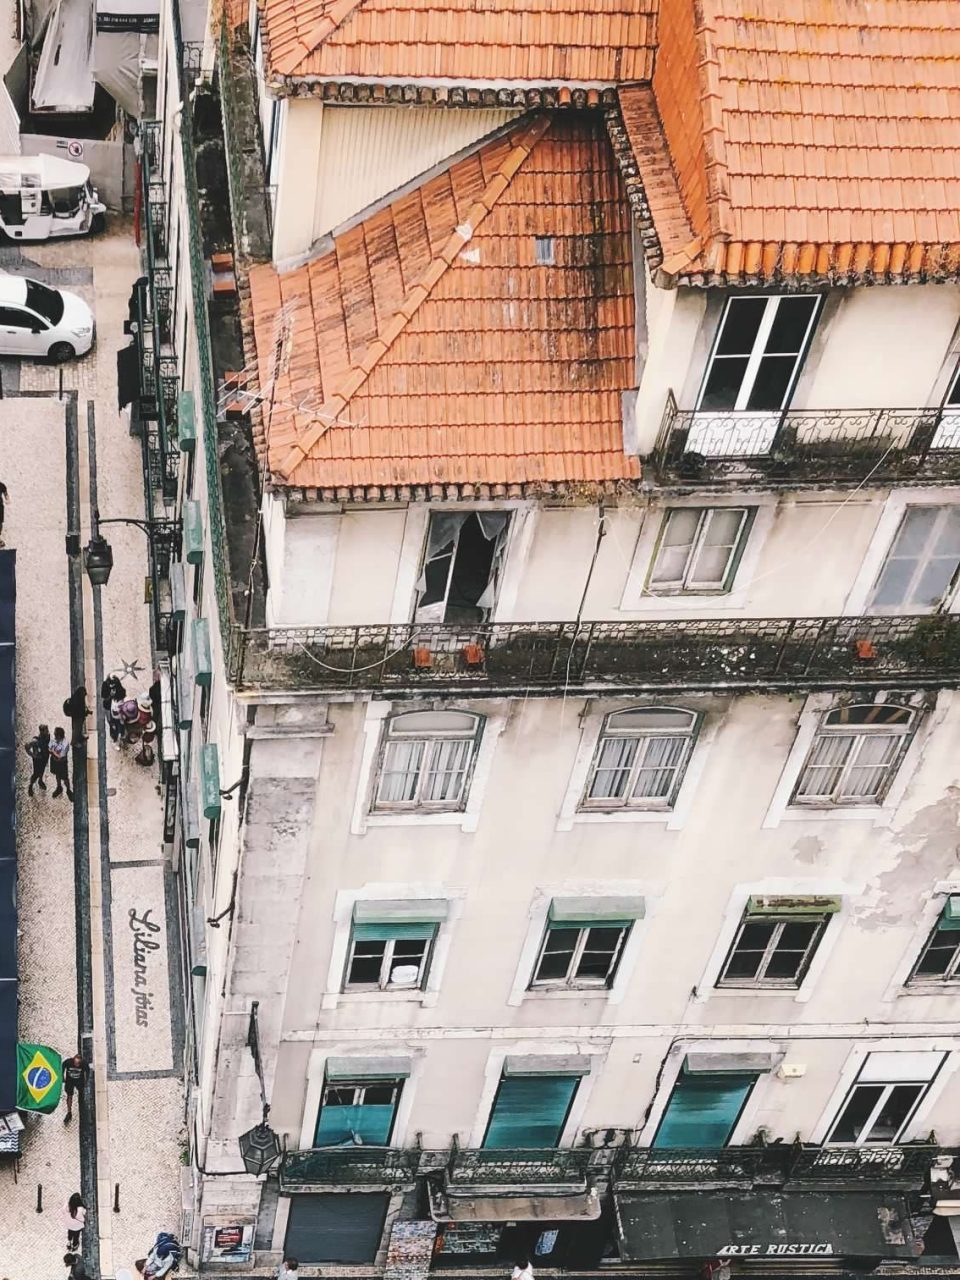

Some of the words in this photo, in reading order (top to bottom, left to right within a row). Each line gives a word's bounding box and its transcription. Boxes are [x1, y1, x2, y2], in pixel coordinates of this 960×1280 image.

[128, 908, 161, 987] Liliana
[716, 1244, 762, 1256] ARTE
[766, 1243, 834, 1256] RUSTICA
